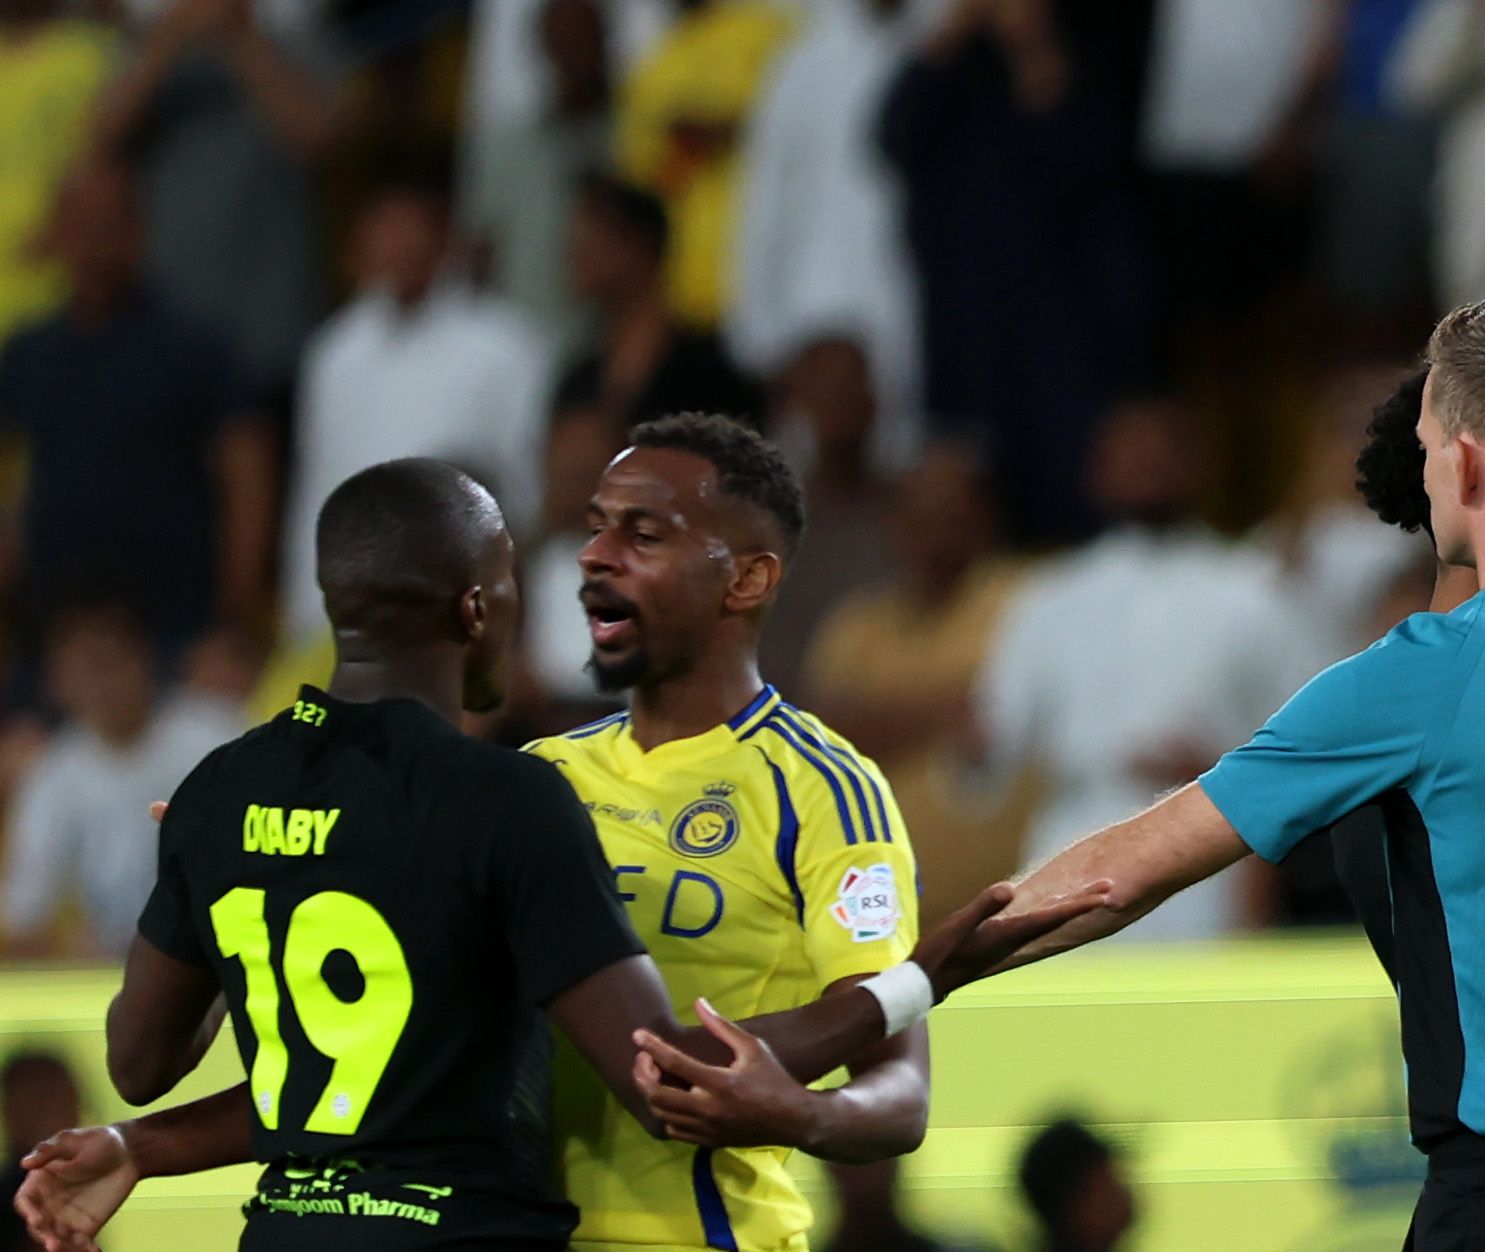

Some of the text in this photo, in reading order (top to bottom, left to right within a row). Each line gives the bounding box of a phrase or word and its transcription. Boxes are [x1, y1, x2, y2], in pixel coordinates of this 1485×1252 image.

[860, 894, 890, 910] RSL
[209, 887, 413, 1136] 19
[347, 1192, 441, 1226] Pharma
